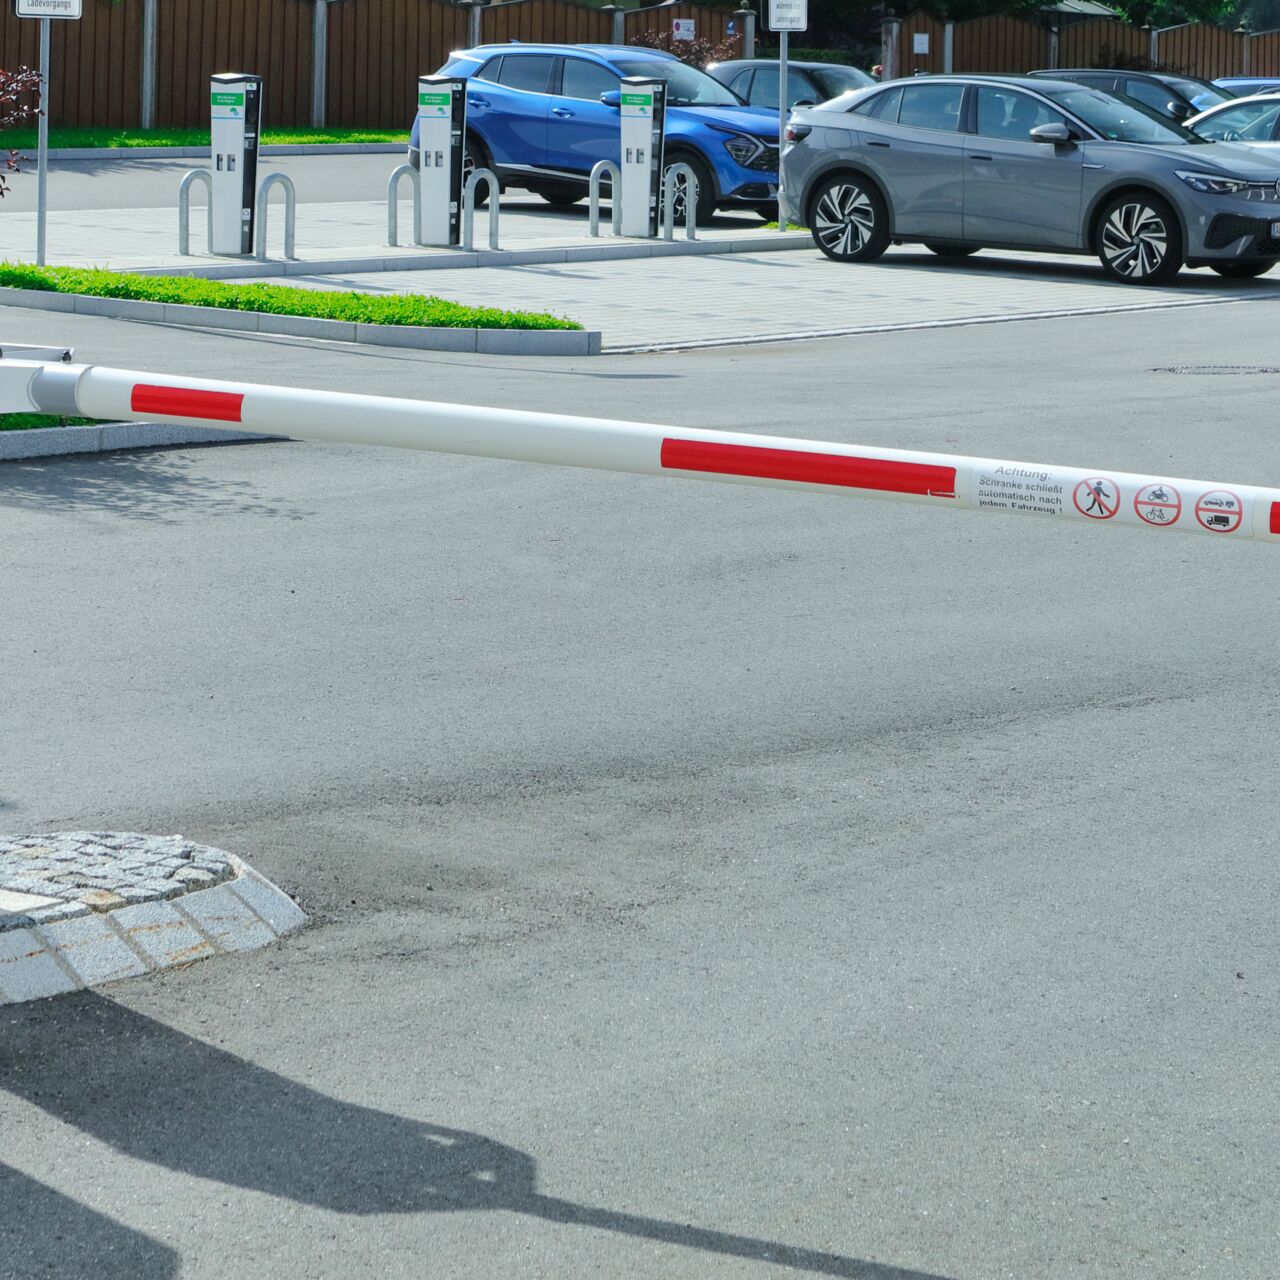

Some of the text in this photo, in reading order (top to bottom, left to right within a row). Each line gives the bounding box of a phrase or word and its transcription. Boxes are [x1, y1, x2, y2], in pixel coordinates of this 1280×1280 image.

[995, 466, 1052, 481] Achtung:
[979, 477, 1063, 495] Schranke schließt
[978, 489, 1062, 505] automatisch nach
[978, 499, 1008, 508] jedem
[1011, 502, 1055, 514] Fahrzeug
